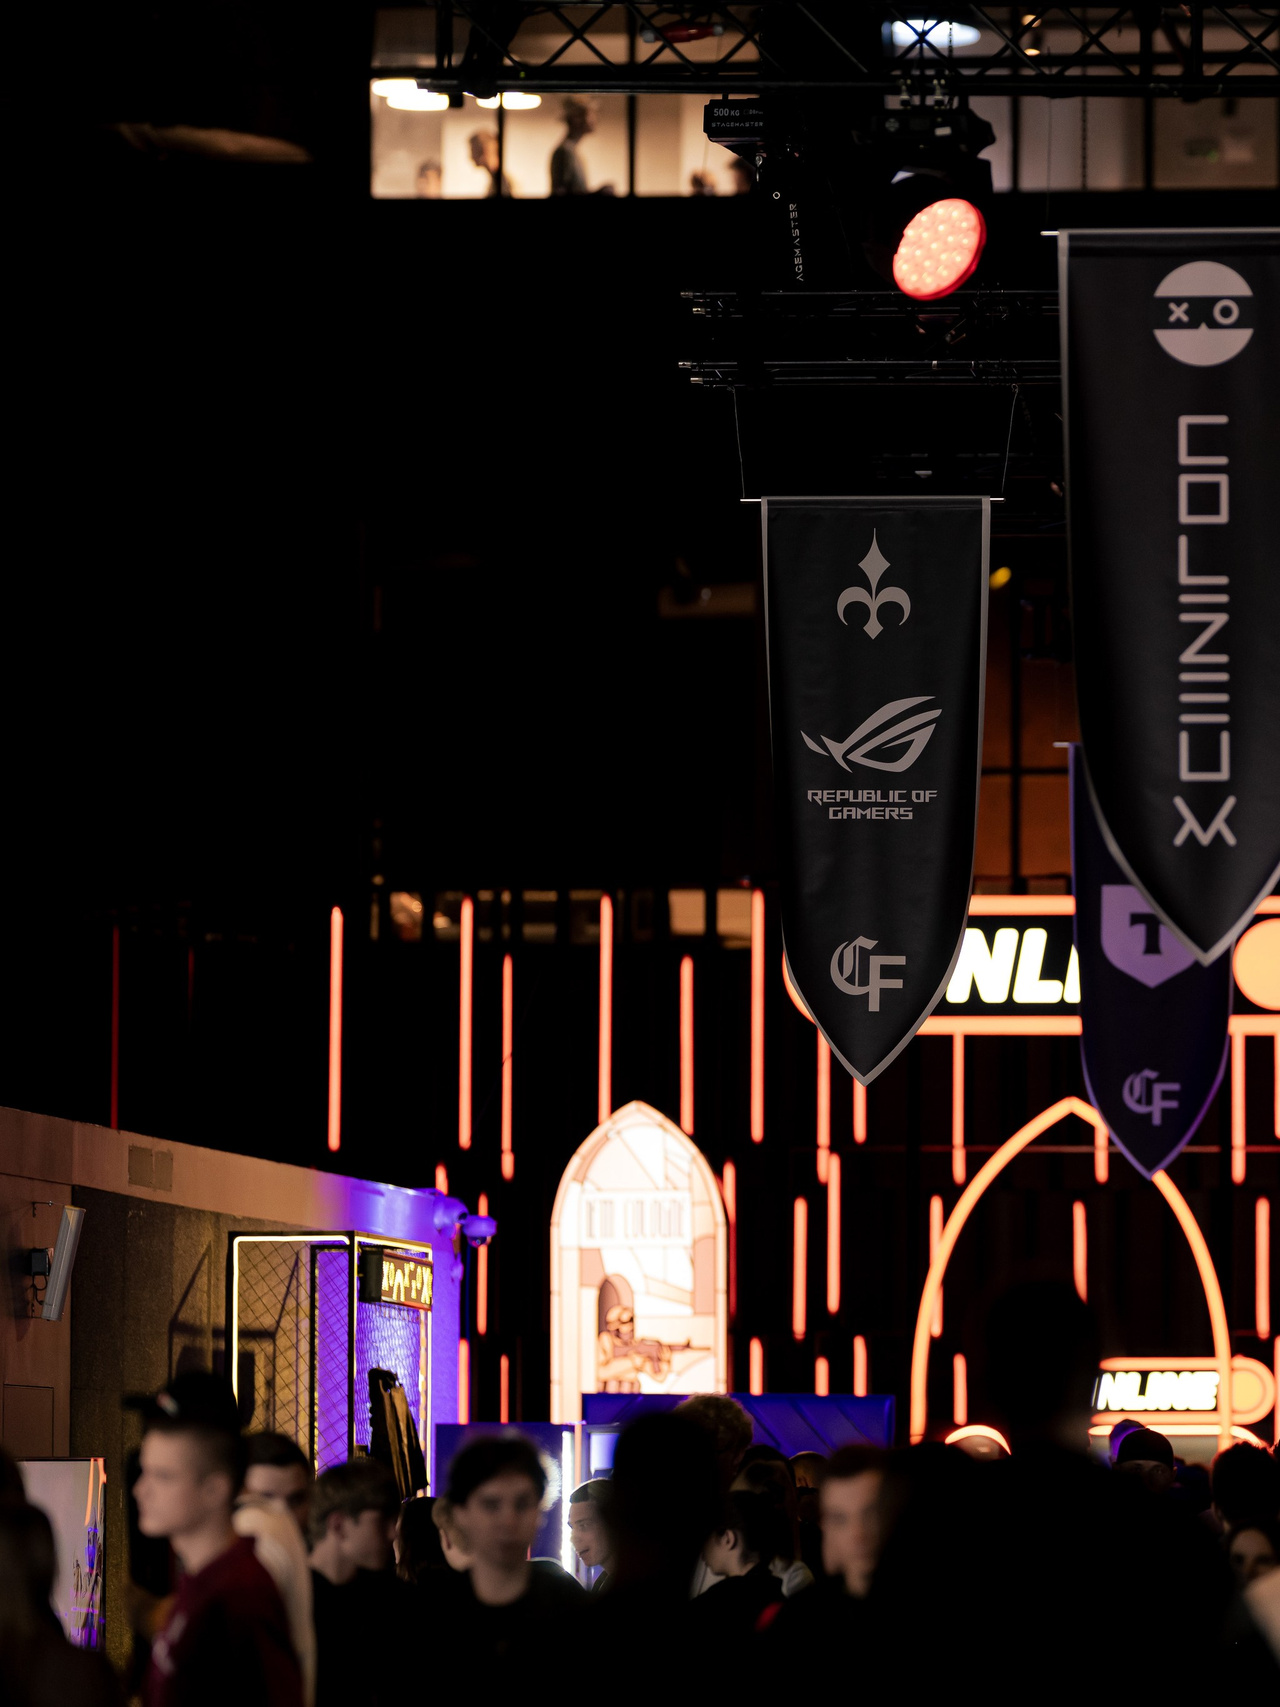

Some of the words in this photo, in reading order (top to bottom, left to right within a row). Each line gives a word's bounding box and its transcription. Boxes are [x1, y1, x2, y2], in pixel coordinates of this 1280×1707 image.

[789, 203, 804, 281] AGEMASTER
[807, 789, 908, 806] REPUBLIC
[911, 789, 938, 803] OF
[828, 807, 914, 820] GAMERS
